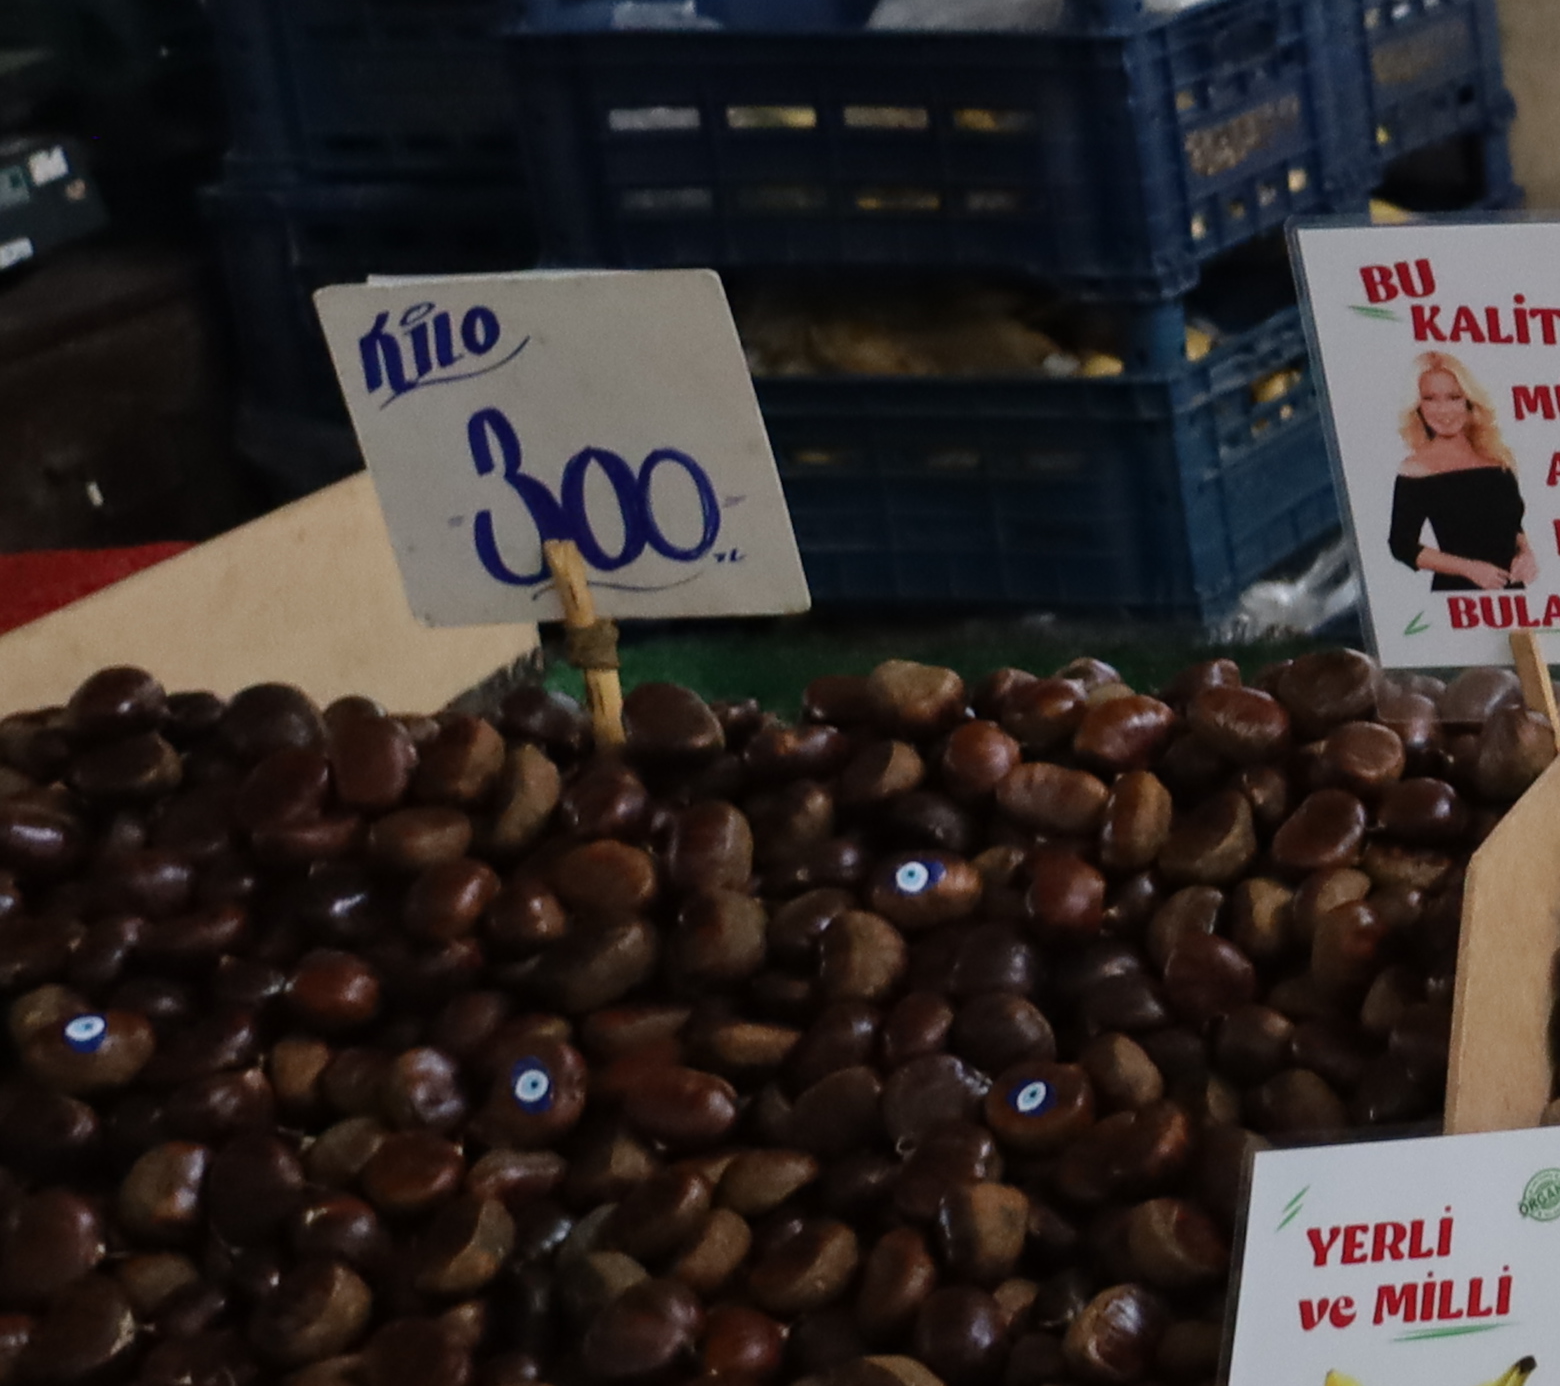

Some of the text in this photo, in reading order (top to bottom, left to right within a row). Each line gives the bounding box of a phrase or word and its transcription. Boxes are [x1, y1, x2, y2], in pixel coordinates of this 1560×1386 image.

[1360, 259, 1436, 304] BU
[1307, 1206, 1453, 1267] YERLİ
[1299, 1265, 1512, 1331] ve MİLLİ
